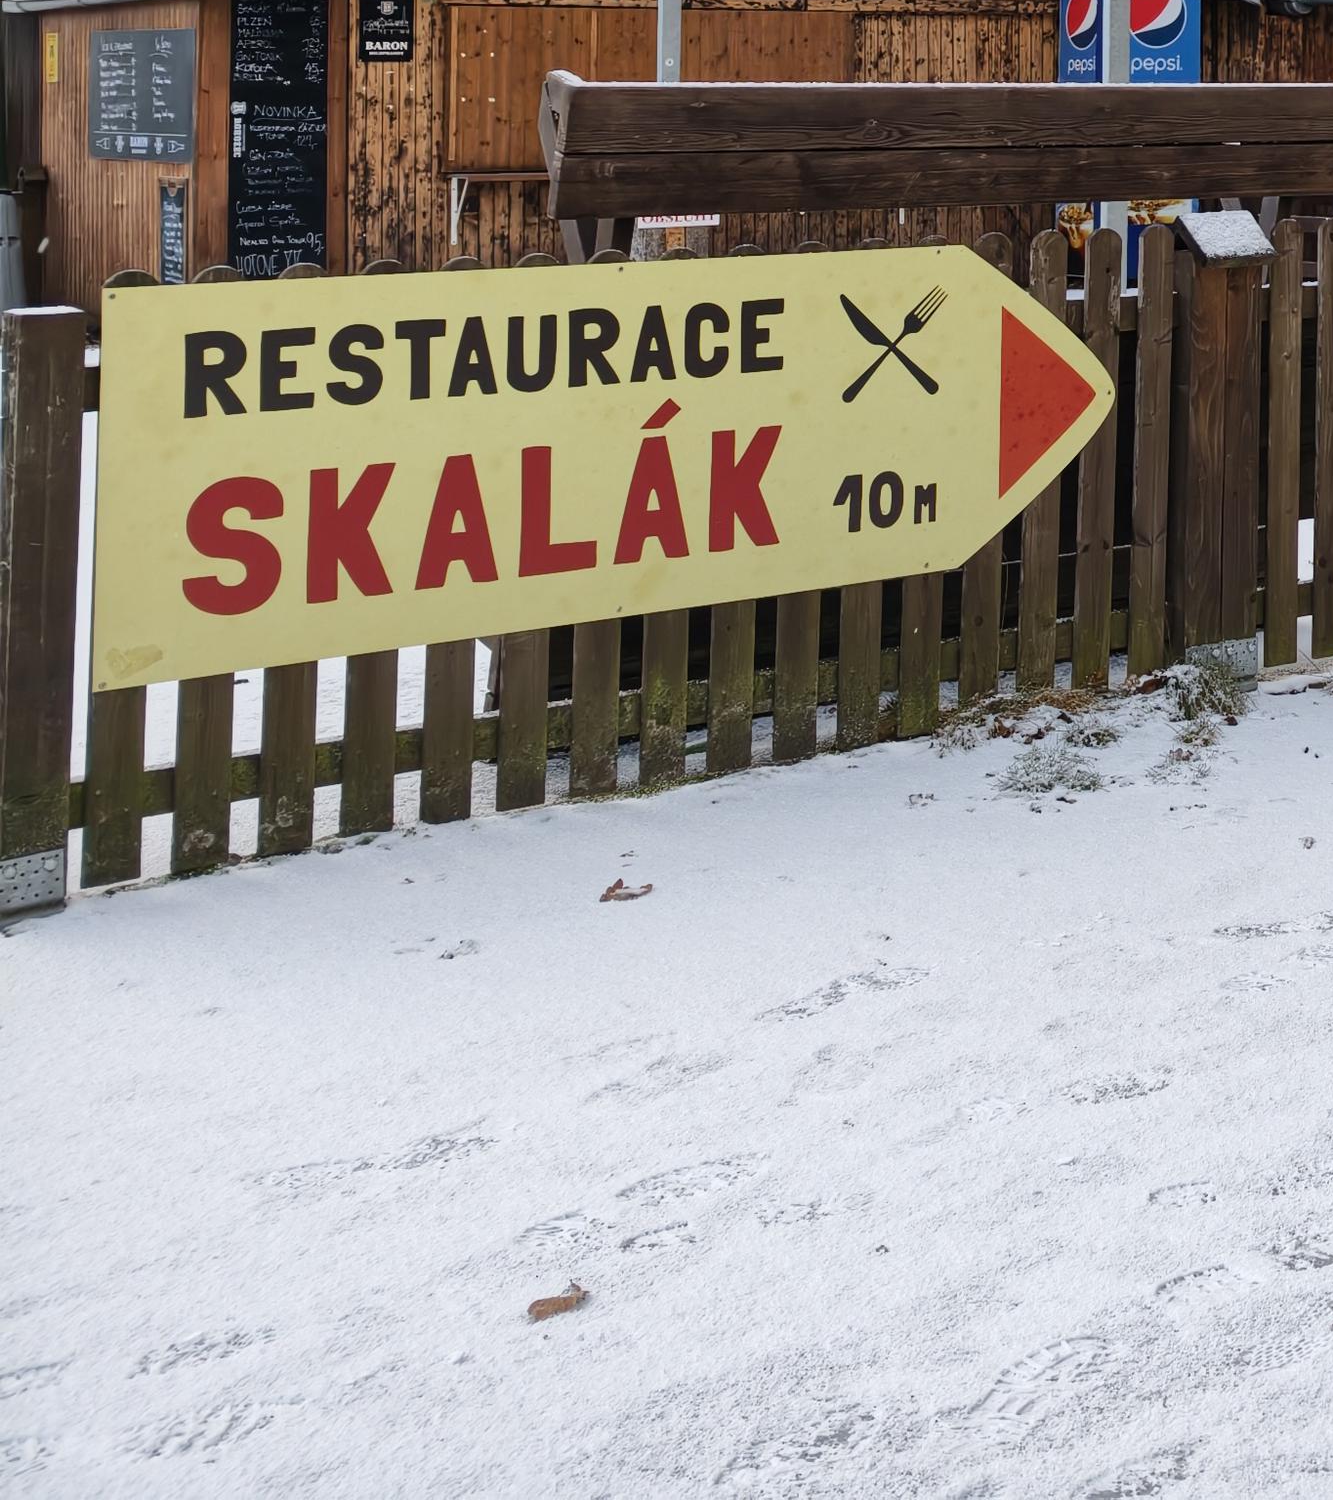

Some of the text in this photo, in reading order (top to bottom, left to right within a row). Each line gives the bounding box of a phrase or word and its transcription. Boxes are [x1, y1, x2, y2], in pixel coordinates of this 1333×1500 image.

[365, 41, 408, 51] BARON
[1067, 55, 1097, 74] pepsi
[254, 104, 317, 118] NOVINKA
[184, 298, 785, 419] RESTAURACE
[182, 398, 783, 616] SKALÁK
